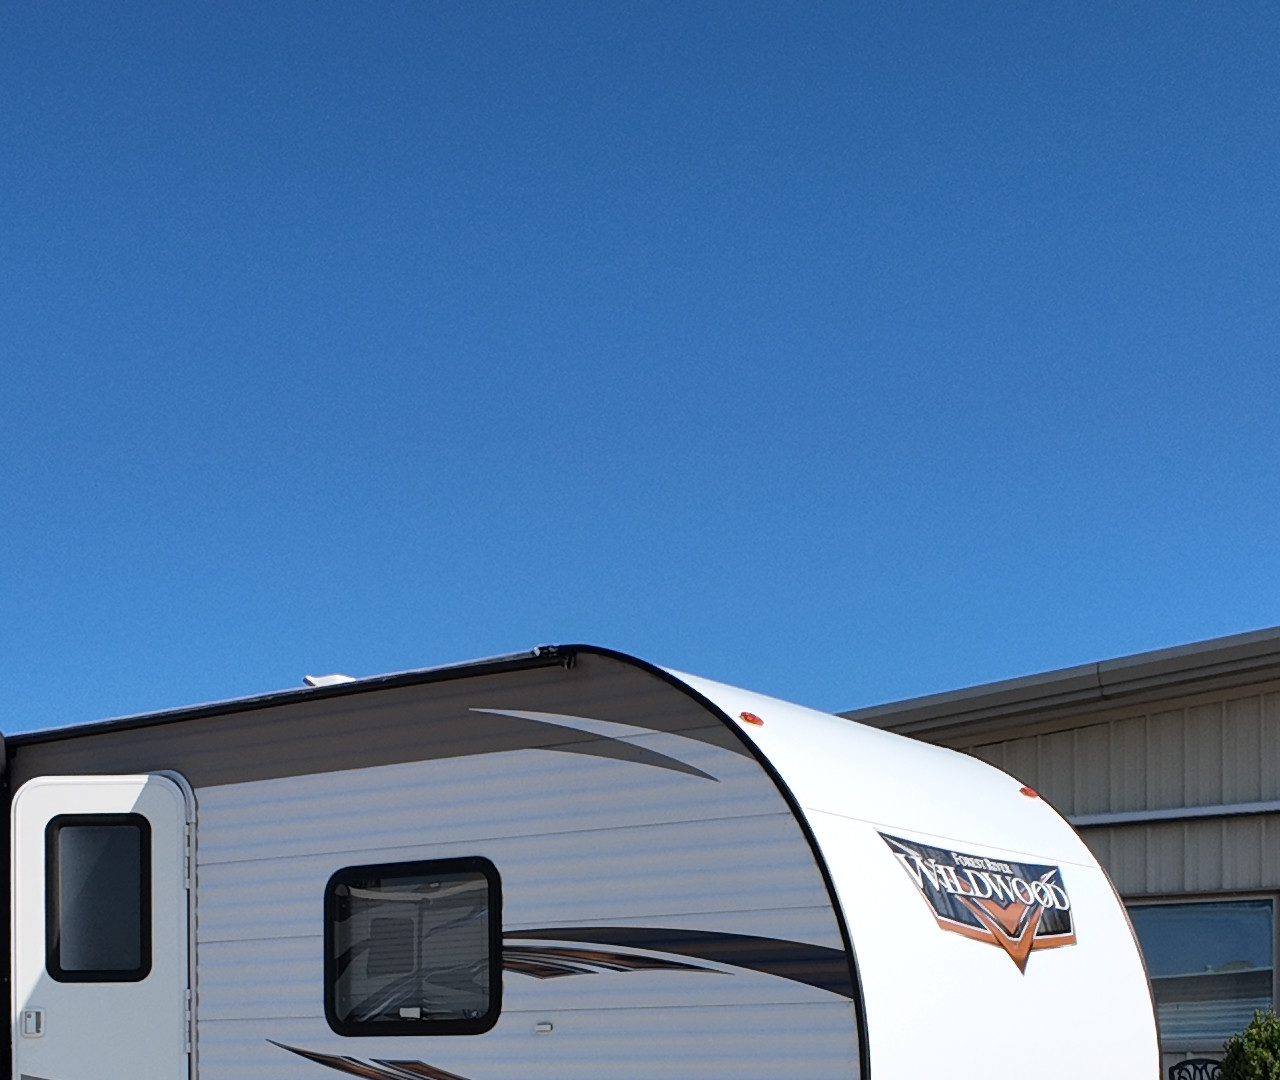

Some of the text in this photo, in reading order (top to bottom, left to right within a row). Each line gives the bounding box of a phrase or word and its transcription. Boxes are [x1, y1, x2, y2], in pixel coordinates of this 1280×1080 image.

[893, 852, 1070, 910] WILDWOOD
[951, 852, 1014, 875] FOREST RIVER
